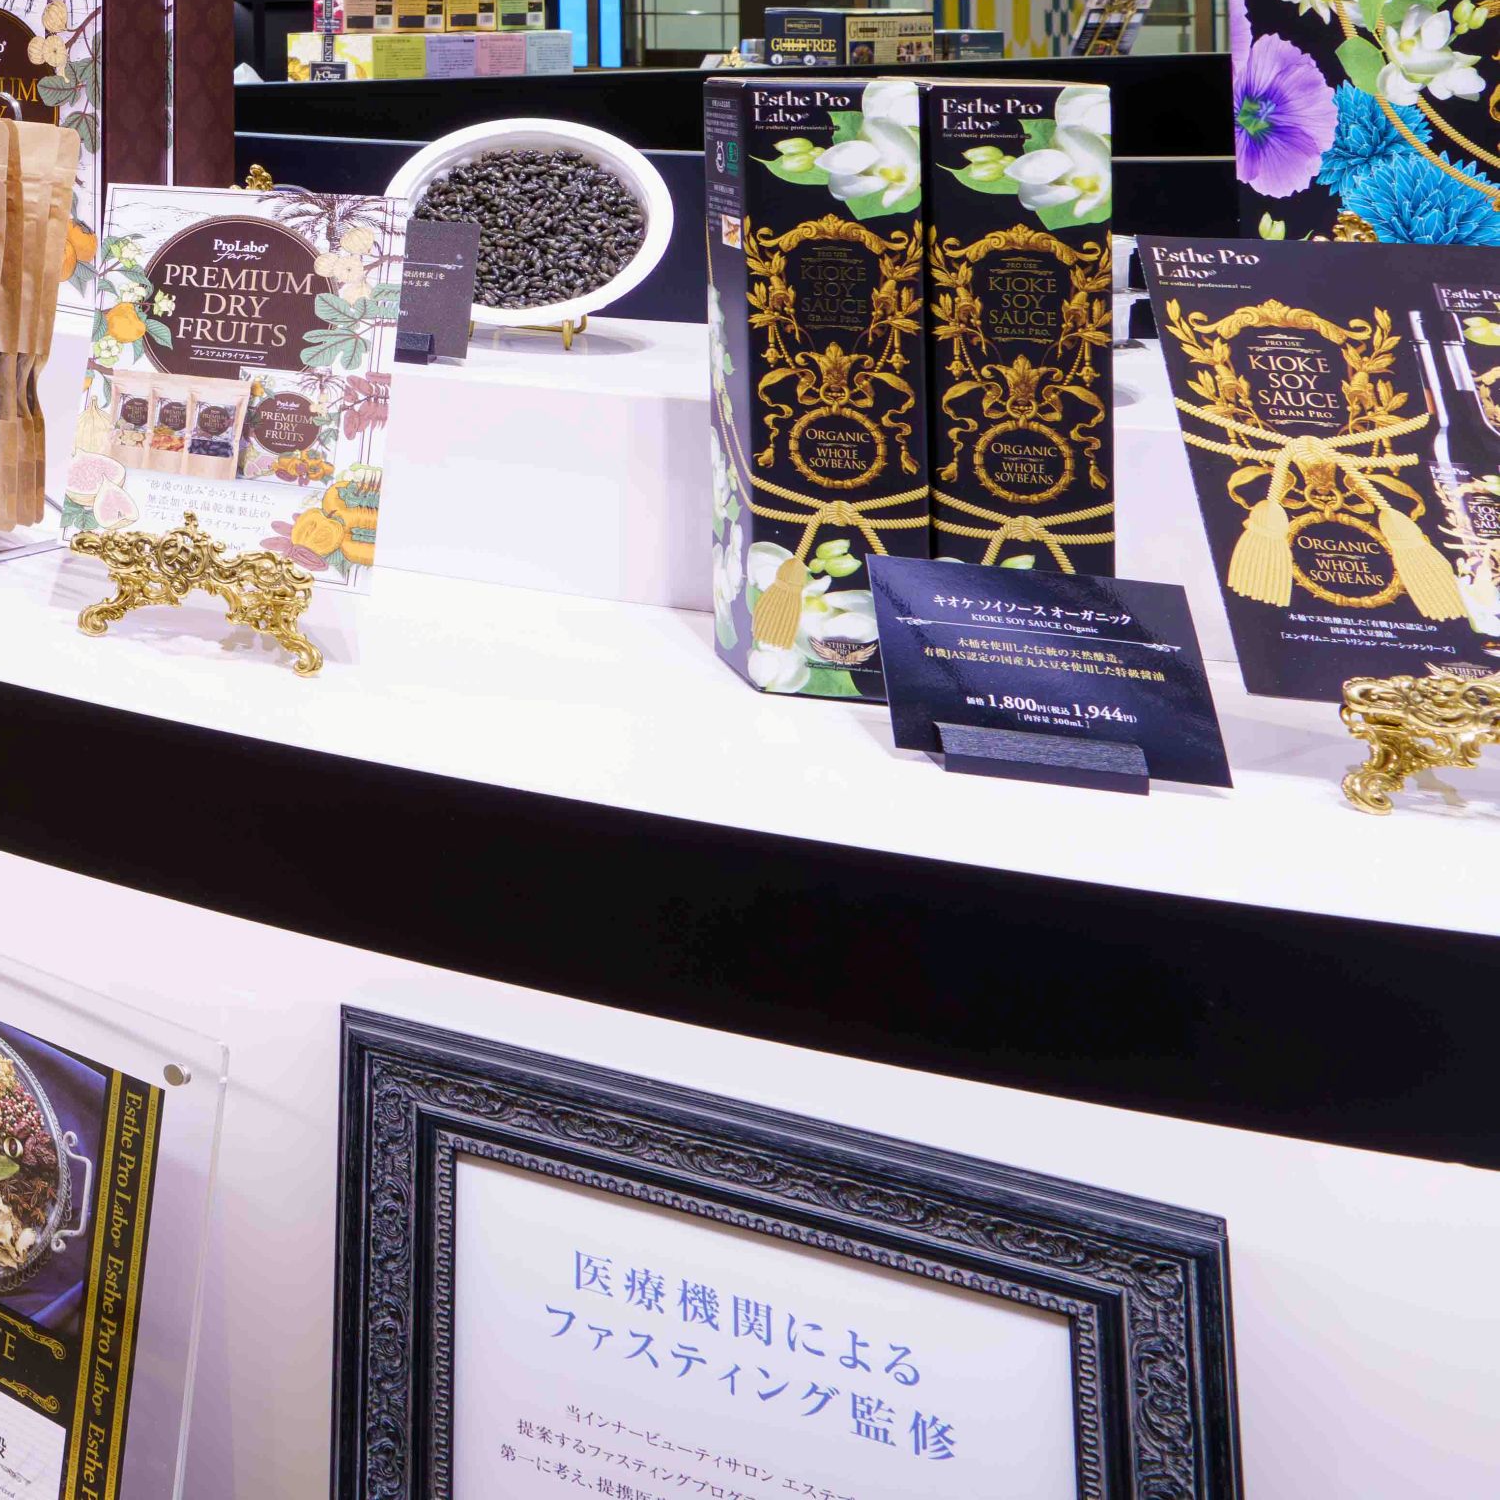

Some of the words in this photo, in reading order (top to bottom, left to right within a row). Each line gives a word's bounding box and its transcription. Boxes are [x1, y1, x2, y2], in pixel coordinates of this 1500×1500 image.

[753, 90, 811, 108] Esthe
[814, 91, 850, 112] Pro
[940, 97, 1003, 116] Esthe
[1006, 98, 1043, 118] Pro
[213, 249, 261, 264] farm
[1152, 247, 1215, 267] Esthe
[1220, 249, 1260, 269] Pro
[164, 263, 315, 297] PREMIUM
[800, 264, 867, 285] KIOKE
[813, 284, 856, 301] SOY
[988, 276, 1057, 294] KIOKE
[1441, 288, 1481, 301] Esthe
[202, 293, 269, 320] DRY
[801, 300, 867, 319] SAUCE
[1001, 294, 1046, 312] SOY
[989, 310, 1057, 331] SAUCE
[176, 317, 288, 348] FRUITS
[994, 327, 1021, 337] GRAN
[192, 349, 266, 363] プレミアムドライフルーツ
[1249, 355, 1331, 375] KIOKE
[1269, 373, 1319, 393] SOY
[1259, 390, 1341, 410] SAUCE
[260, 411, 314, 427] PREMIUM
[1269, 407, 1304, 419] GRAN
[265, 429, 305, 443] FRUITS
[274, 421, 297, 432] DRY
[805, 428, 870, 444] ORGANIC
[816, 447, 859, 461] WHOLE
[991, 442, 1058, 459] ORGANIC
[809, 457, 867, 473] SOYBEANS
[1001, 461, 1046, 476] WHOLE
[994, 471, 1054, 487] SOYBEANS
[1298, 536, 1381, 556] ORGANIC
[1316, 558, 1370, 576] WHOLE
[1310, 569, 1385, 589] SOYBEANS
[932, 594, 974, 611] キオケ
[977, 599, 1046, 619] ソイソース
[1051, 605, 1132, 629] オーガニック
[971, 613, 1004, 625] KIOKE
[1005, 616, 1026, 628] SOY
[1027, 618, 1062, 633] SAUCE
[1063, 623, 1099, 638] Organic
[966, 695, 985, 708] 価格
[120, 1090, 143, 1145] Esthe
[99, 1254, 125, 1313] Esthe
[571, 1248, 923, 1389] 医療機関による
[543, 1301, 959, 1463] ファスティング監修
[565, 1404, 775, 1483] 当インナービューティサロン
